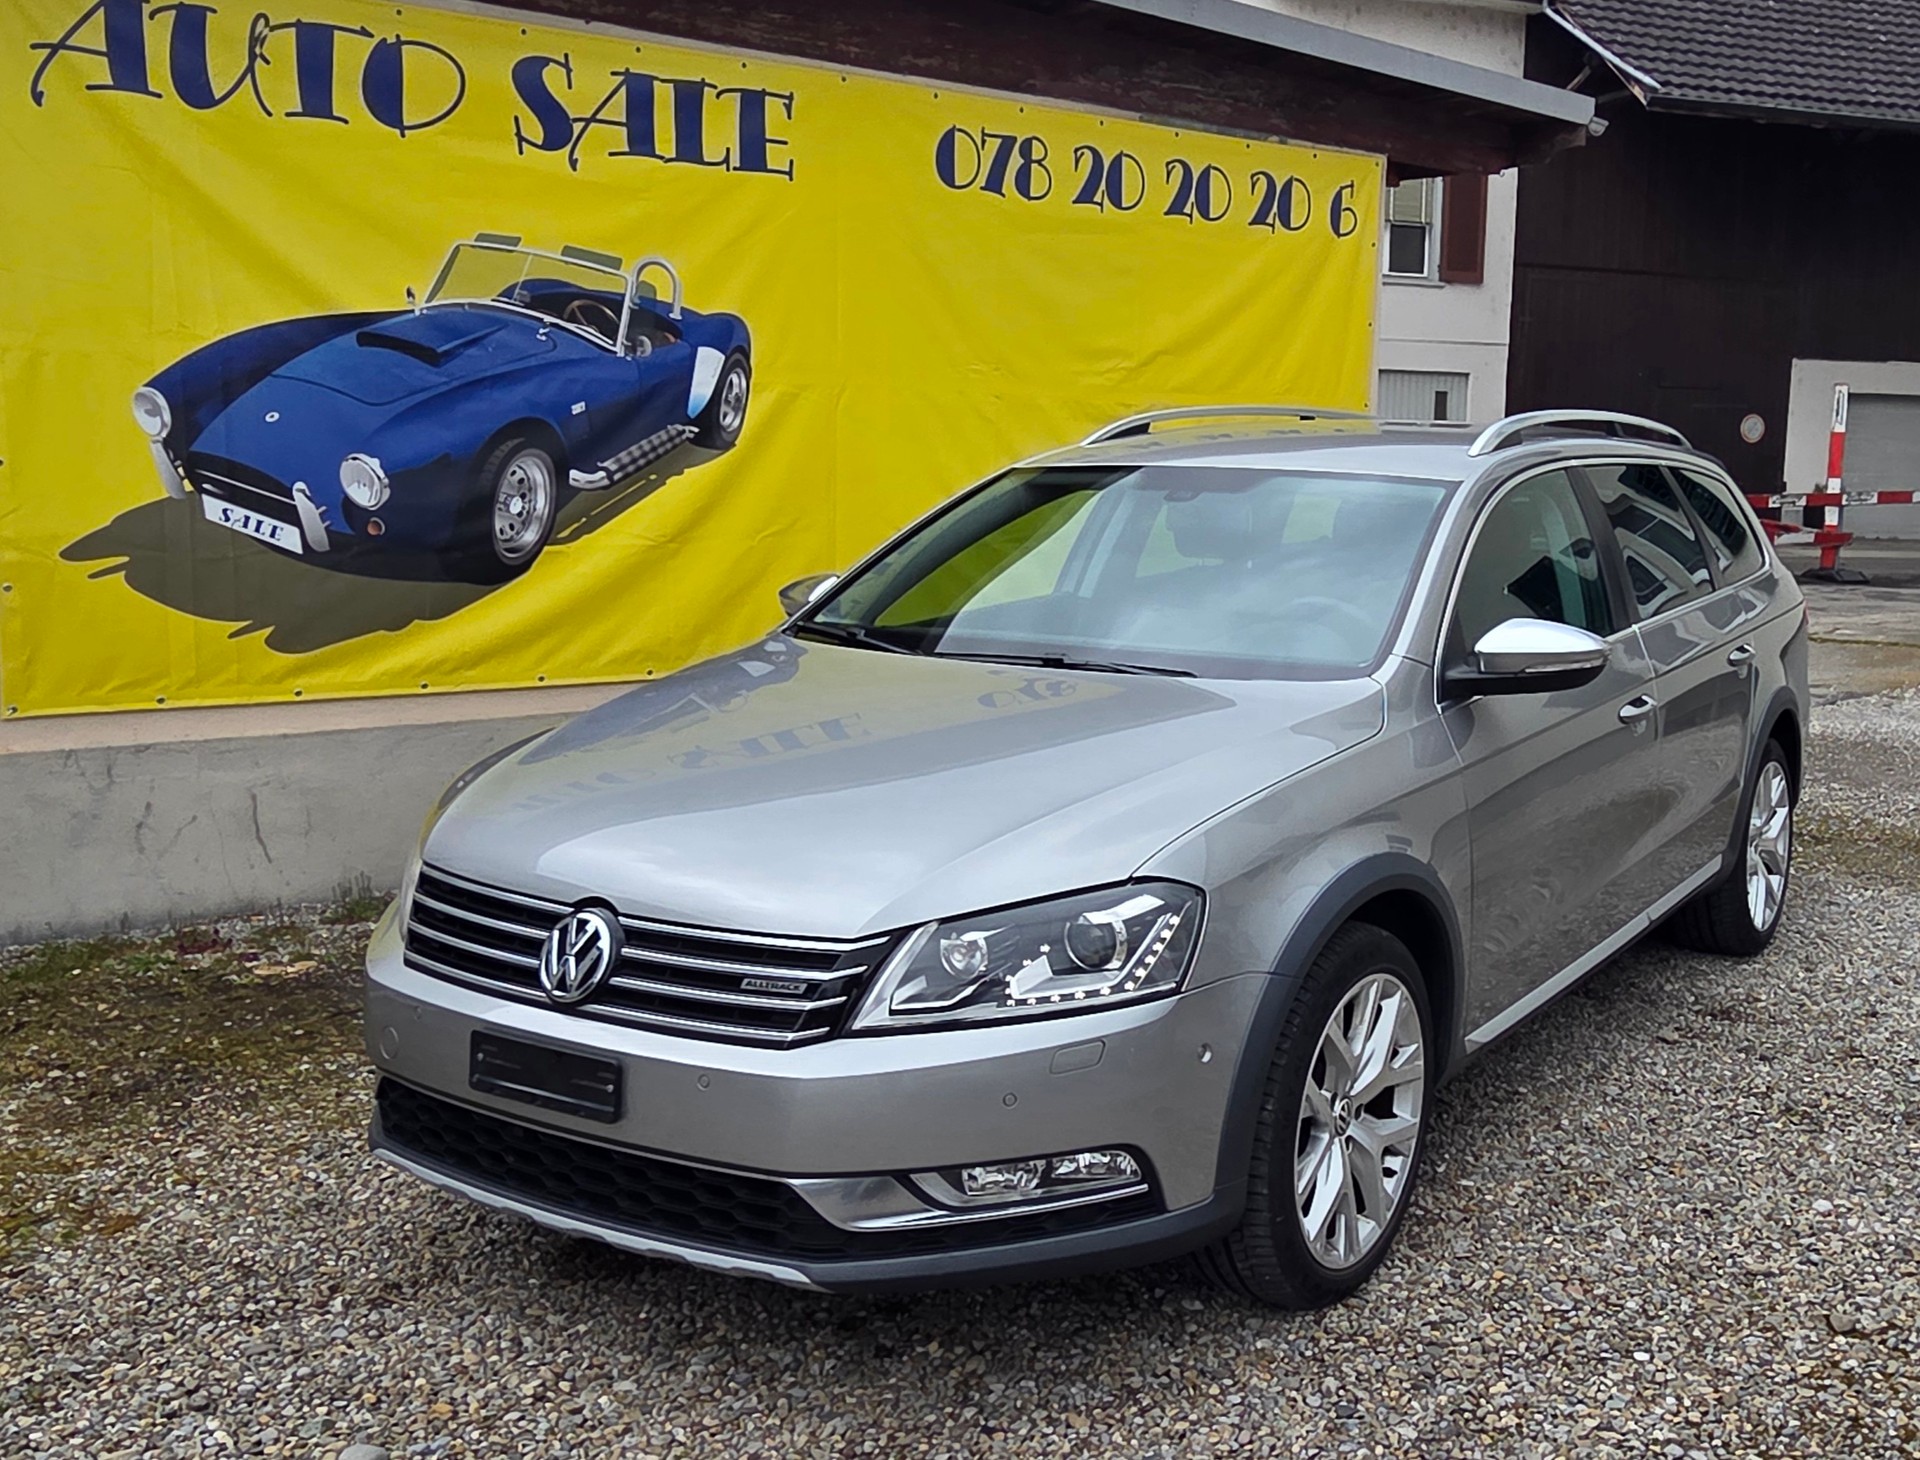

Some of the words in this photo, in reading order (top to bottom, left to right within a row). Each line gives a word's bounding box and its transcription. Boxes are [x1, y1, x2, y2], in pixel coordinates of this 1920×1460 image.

[30, 0, 466, 137] AUTO
[511, 53, 794, 181] SALE
[935, 125, 1052, 201] 078
[1072, 145, 1146, 213] 20
[1163, 158, 1232, 224] 20
[1248, 170, 1312, 234] 20
[1329, 180, 1358, 238] 6
[219, 507, 284, 541] SALE
[744, 979, 802, 992] ALLTRACK
